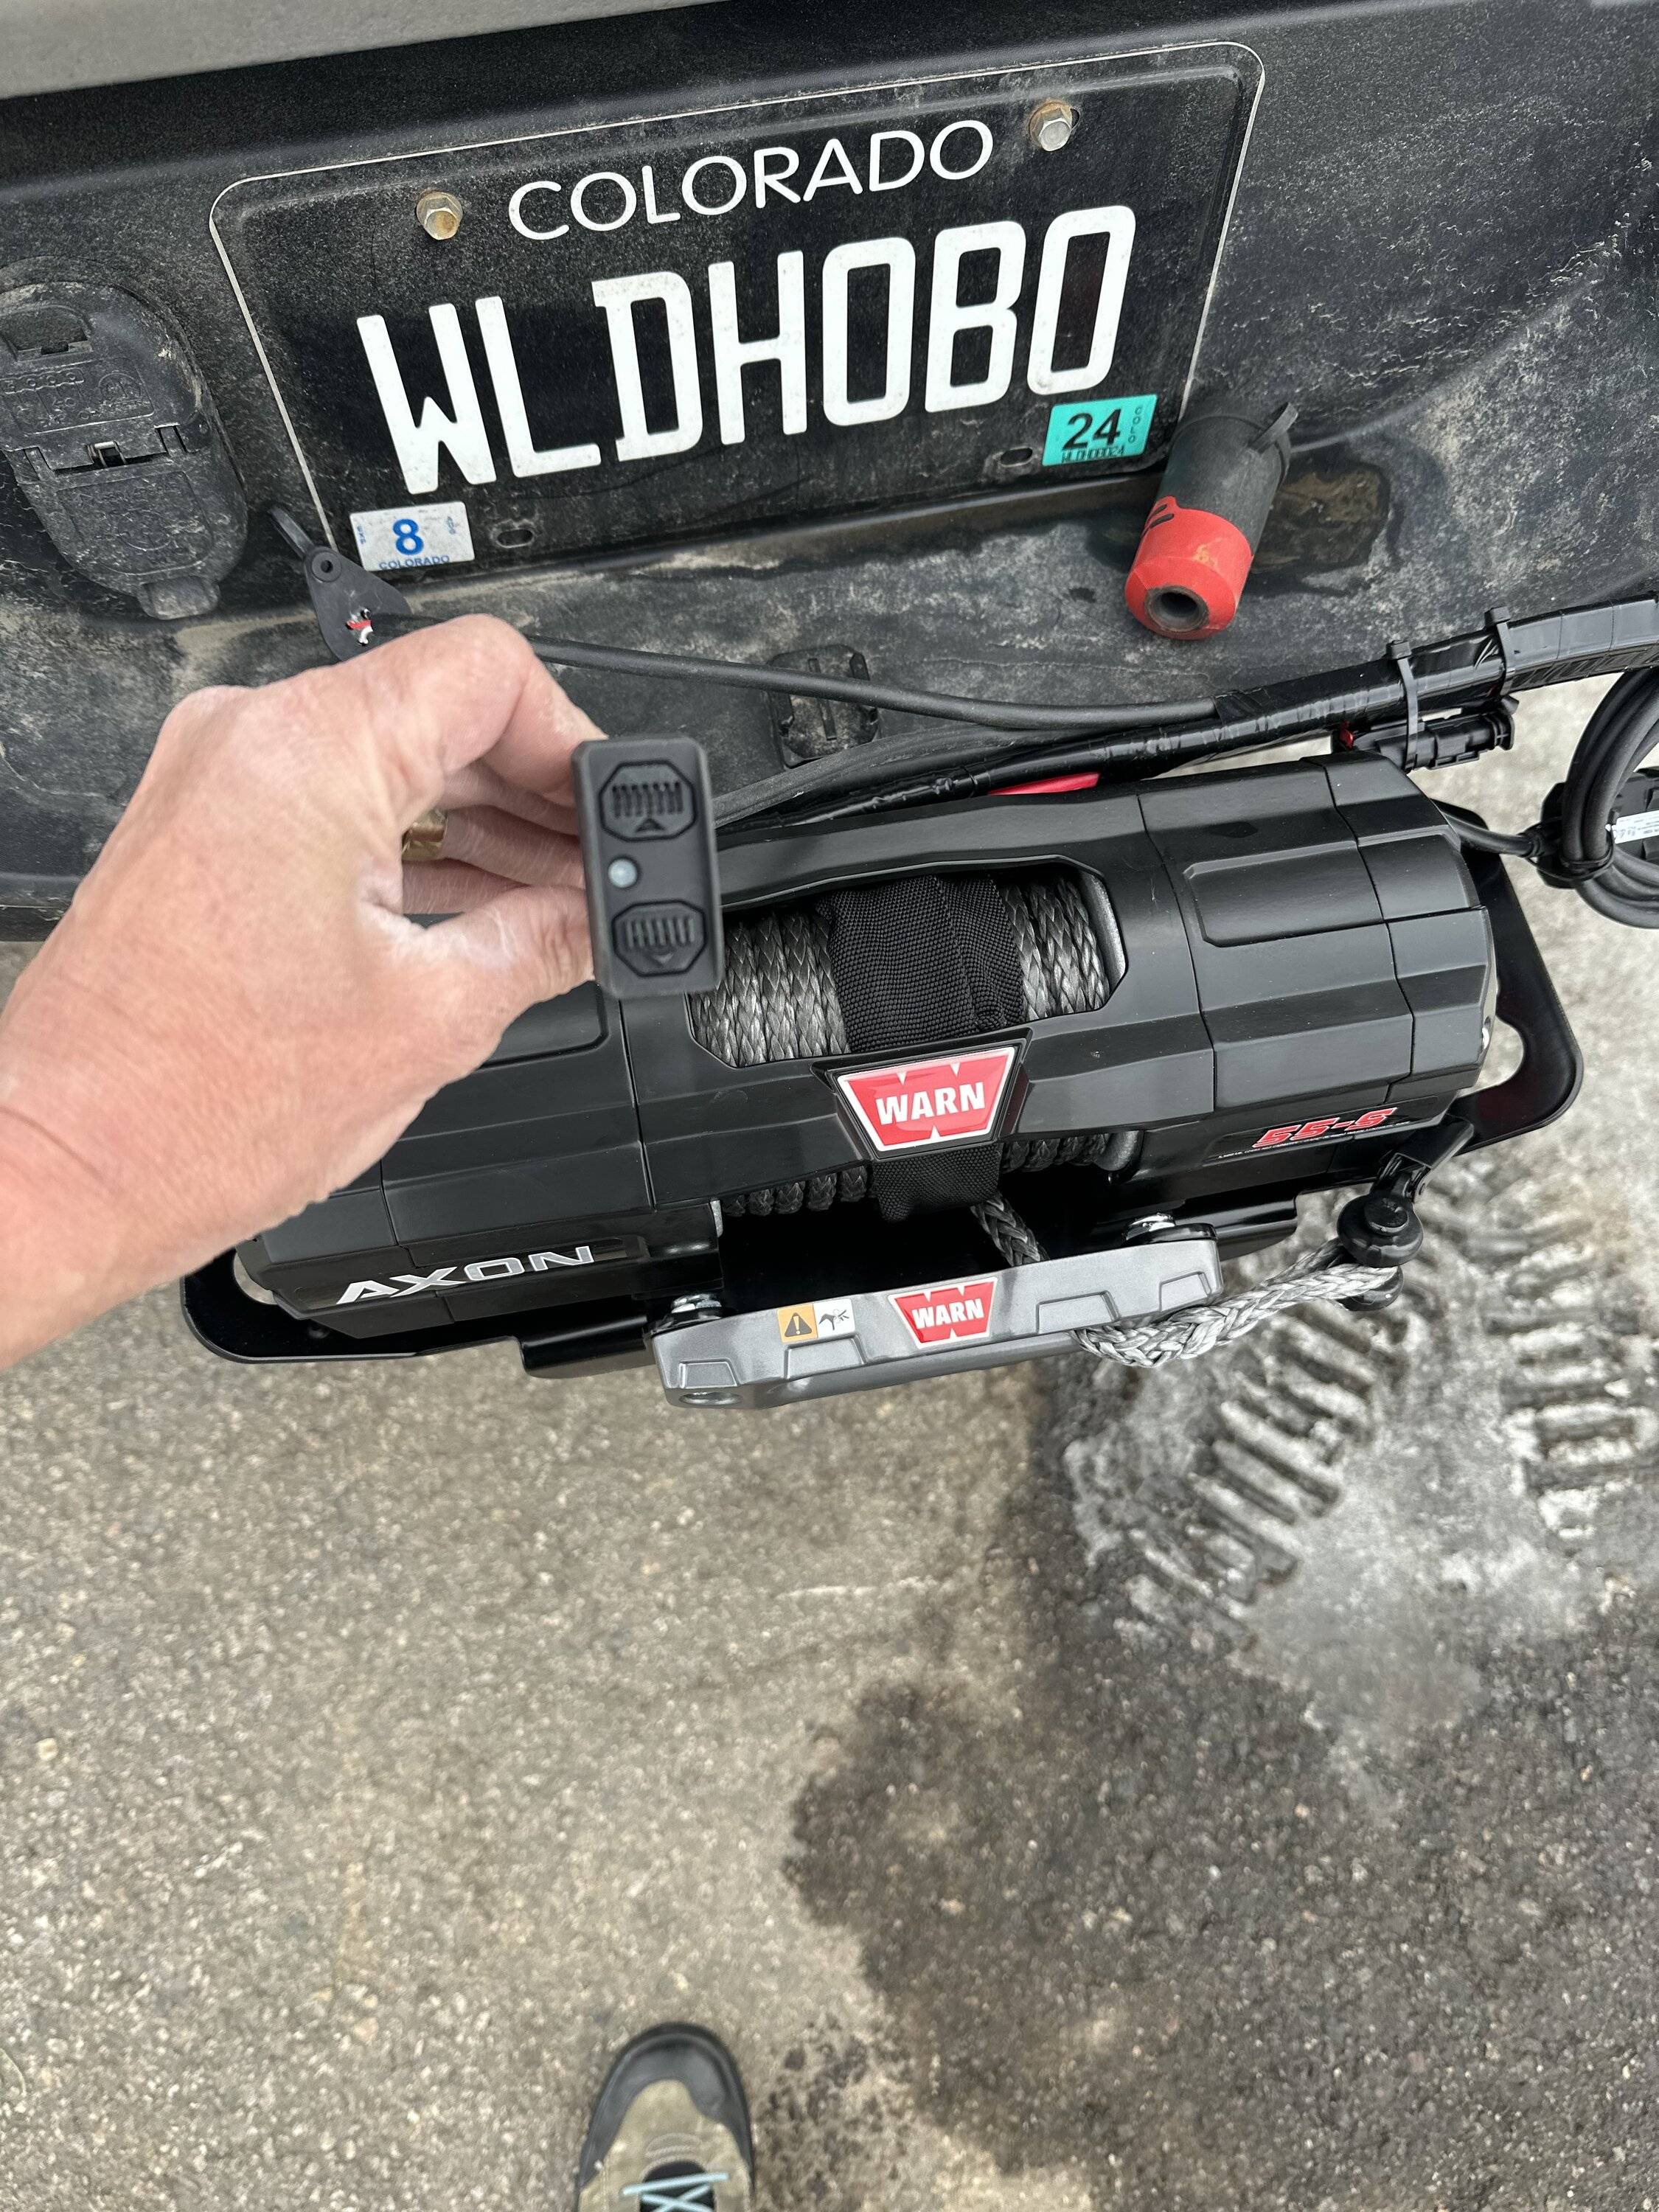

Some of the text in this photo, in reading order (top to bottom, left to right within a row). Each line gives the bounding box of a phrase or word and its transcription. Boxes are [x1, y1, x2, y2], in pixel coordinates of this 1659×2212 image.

[508, 119, 994, 242] COLORADO
[356, 205, 1136, 495] WLDHOBO
[1062, 408, 1121, 451] 24
[392, 518, 424, 555] 8
[379, 554, 450, 571] COLORADO
[876, 1082, 986, 1125] WARN
[336, 1245, 594, 1304] AXON
[911, 1298, 985, 1329] WARN
